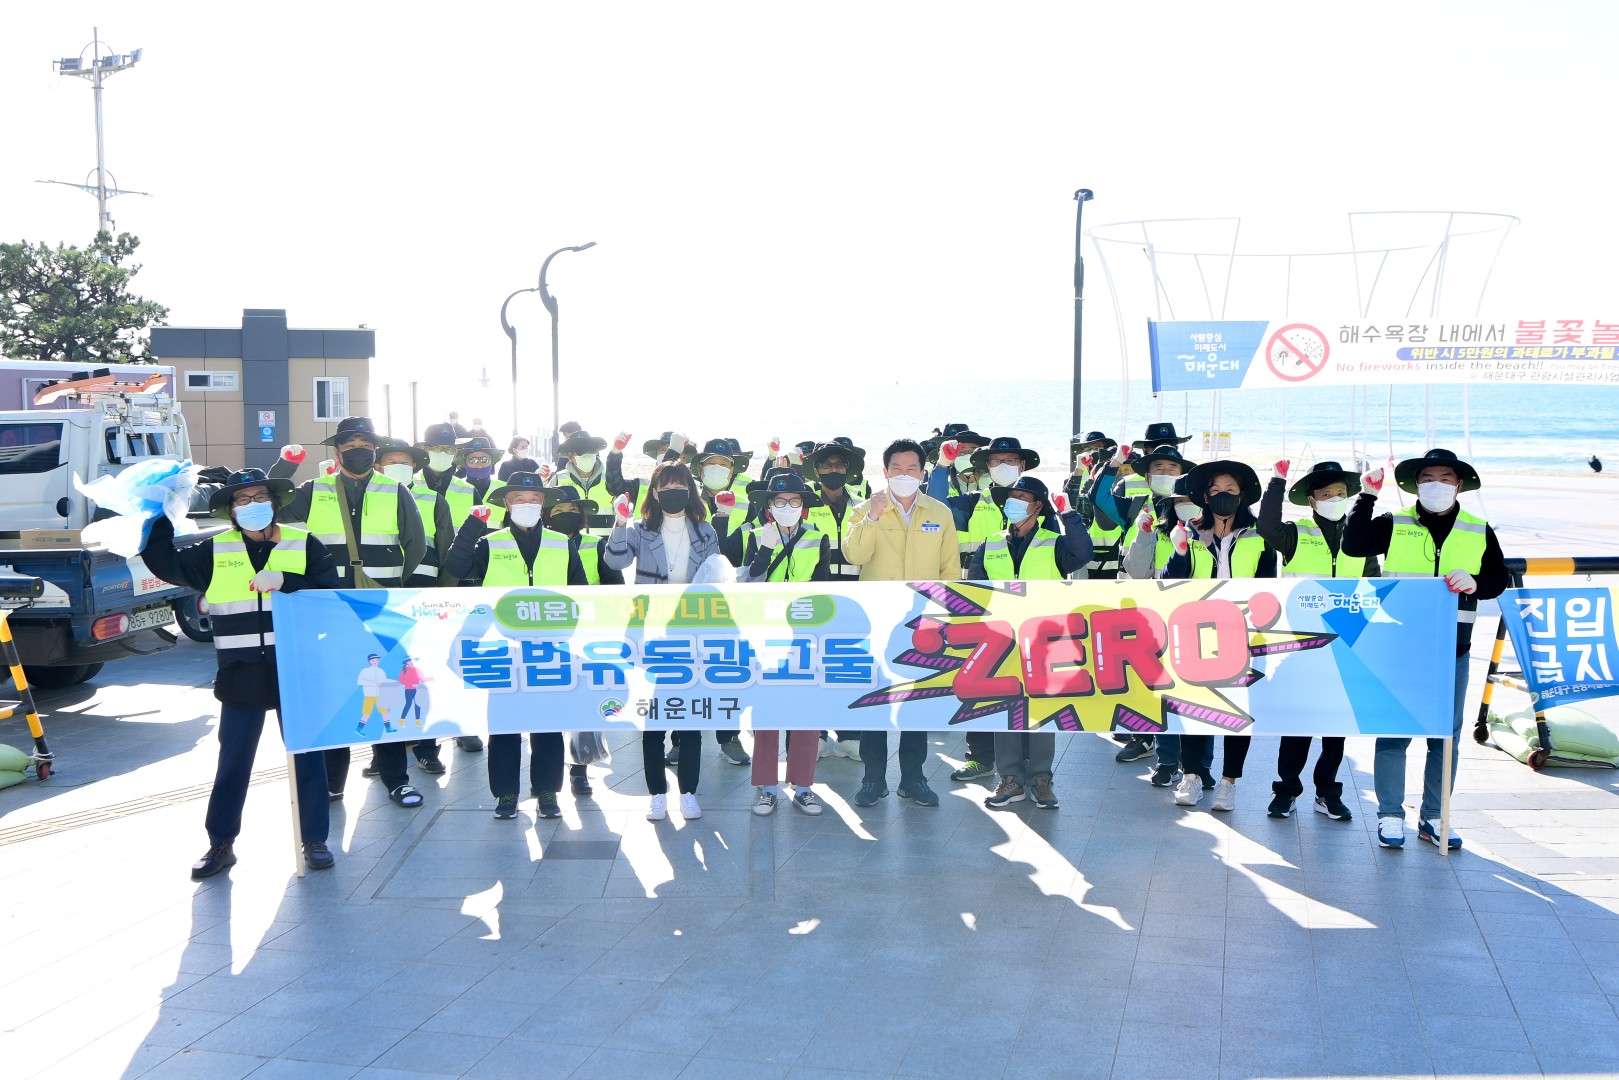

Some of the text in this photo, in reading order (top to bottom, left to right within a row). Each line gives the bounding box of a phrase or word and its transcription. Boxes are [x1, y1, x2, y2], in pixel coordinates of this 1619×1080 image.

[1189, 333, 1222, 343] 사람중심
[1339, 324, 1429, 344] 해수욕장
[1439, 323, 1505, 343] 내에서
[1194, 343, 1226, 353] 미래도시
[1410, 347, 1438, 360] 위반
[1440, 347, 1455, 360] 시
[1457, 347, 1508, 360] 5만원의
[1177, 352, 1240, 378] 해운대
[1336, 363, 1354, 372] No
[1359, 361, 1420, 372] fireworks
[1426, 360, 1465, 371] inside
[1470, 360, 1492, 371] the
[1496, 360, 1544, 370] beach!!
[1482, 371, 1526, 382] 해운대구
[515, 600, 596, 622] 해운대
[1328, 593, 1379, 612] 해운대
[148, 608, 171, 624] 9280
[1514, 596, 1607, 639] 진입
[458, 638, 875, 689] 불법유동광고물
[1531, 643, 1614, 683] 금지
[1541, 684, 1570, 700] 해운대구
[635, 697, 741, 721] 해운대구
